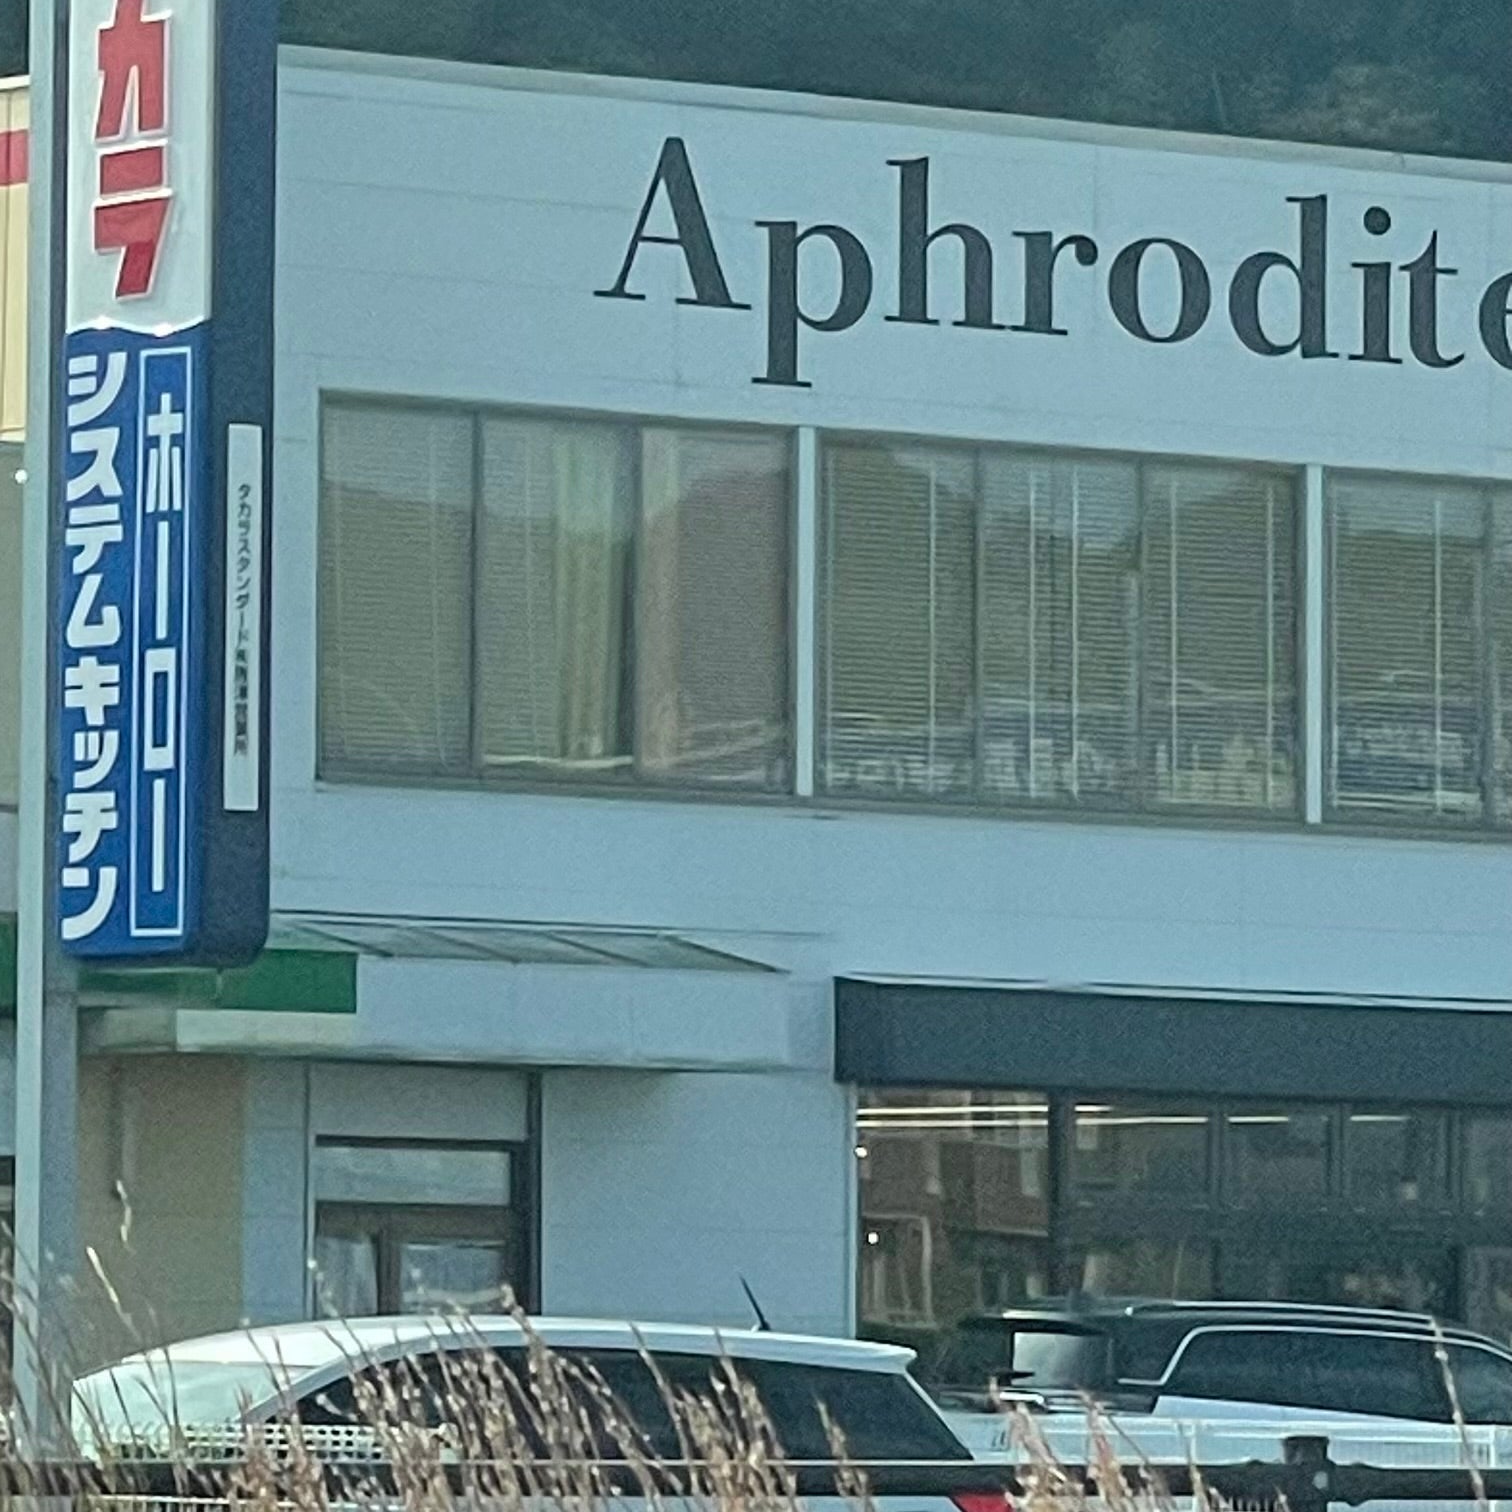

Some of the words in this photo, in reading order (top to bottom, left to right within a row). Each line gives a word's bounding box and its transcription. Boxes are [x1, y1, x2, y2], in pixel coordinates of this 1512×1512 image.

[61, 351, 129, 941] システムキッチン
[144, 392, 183, 893] ホーロー
